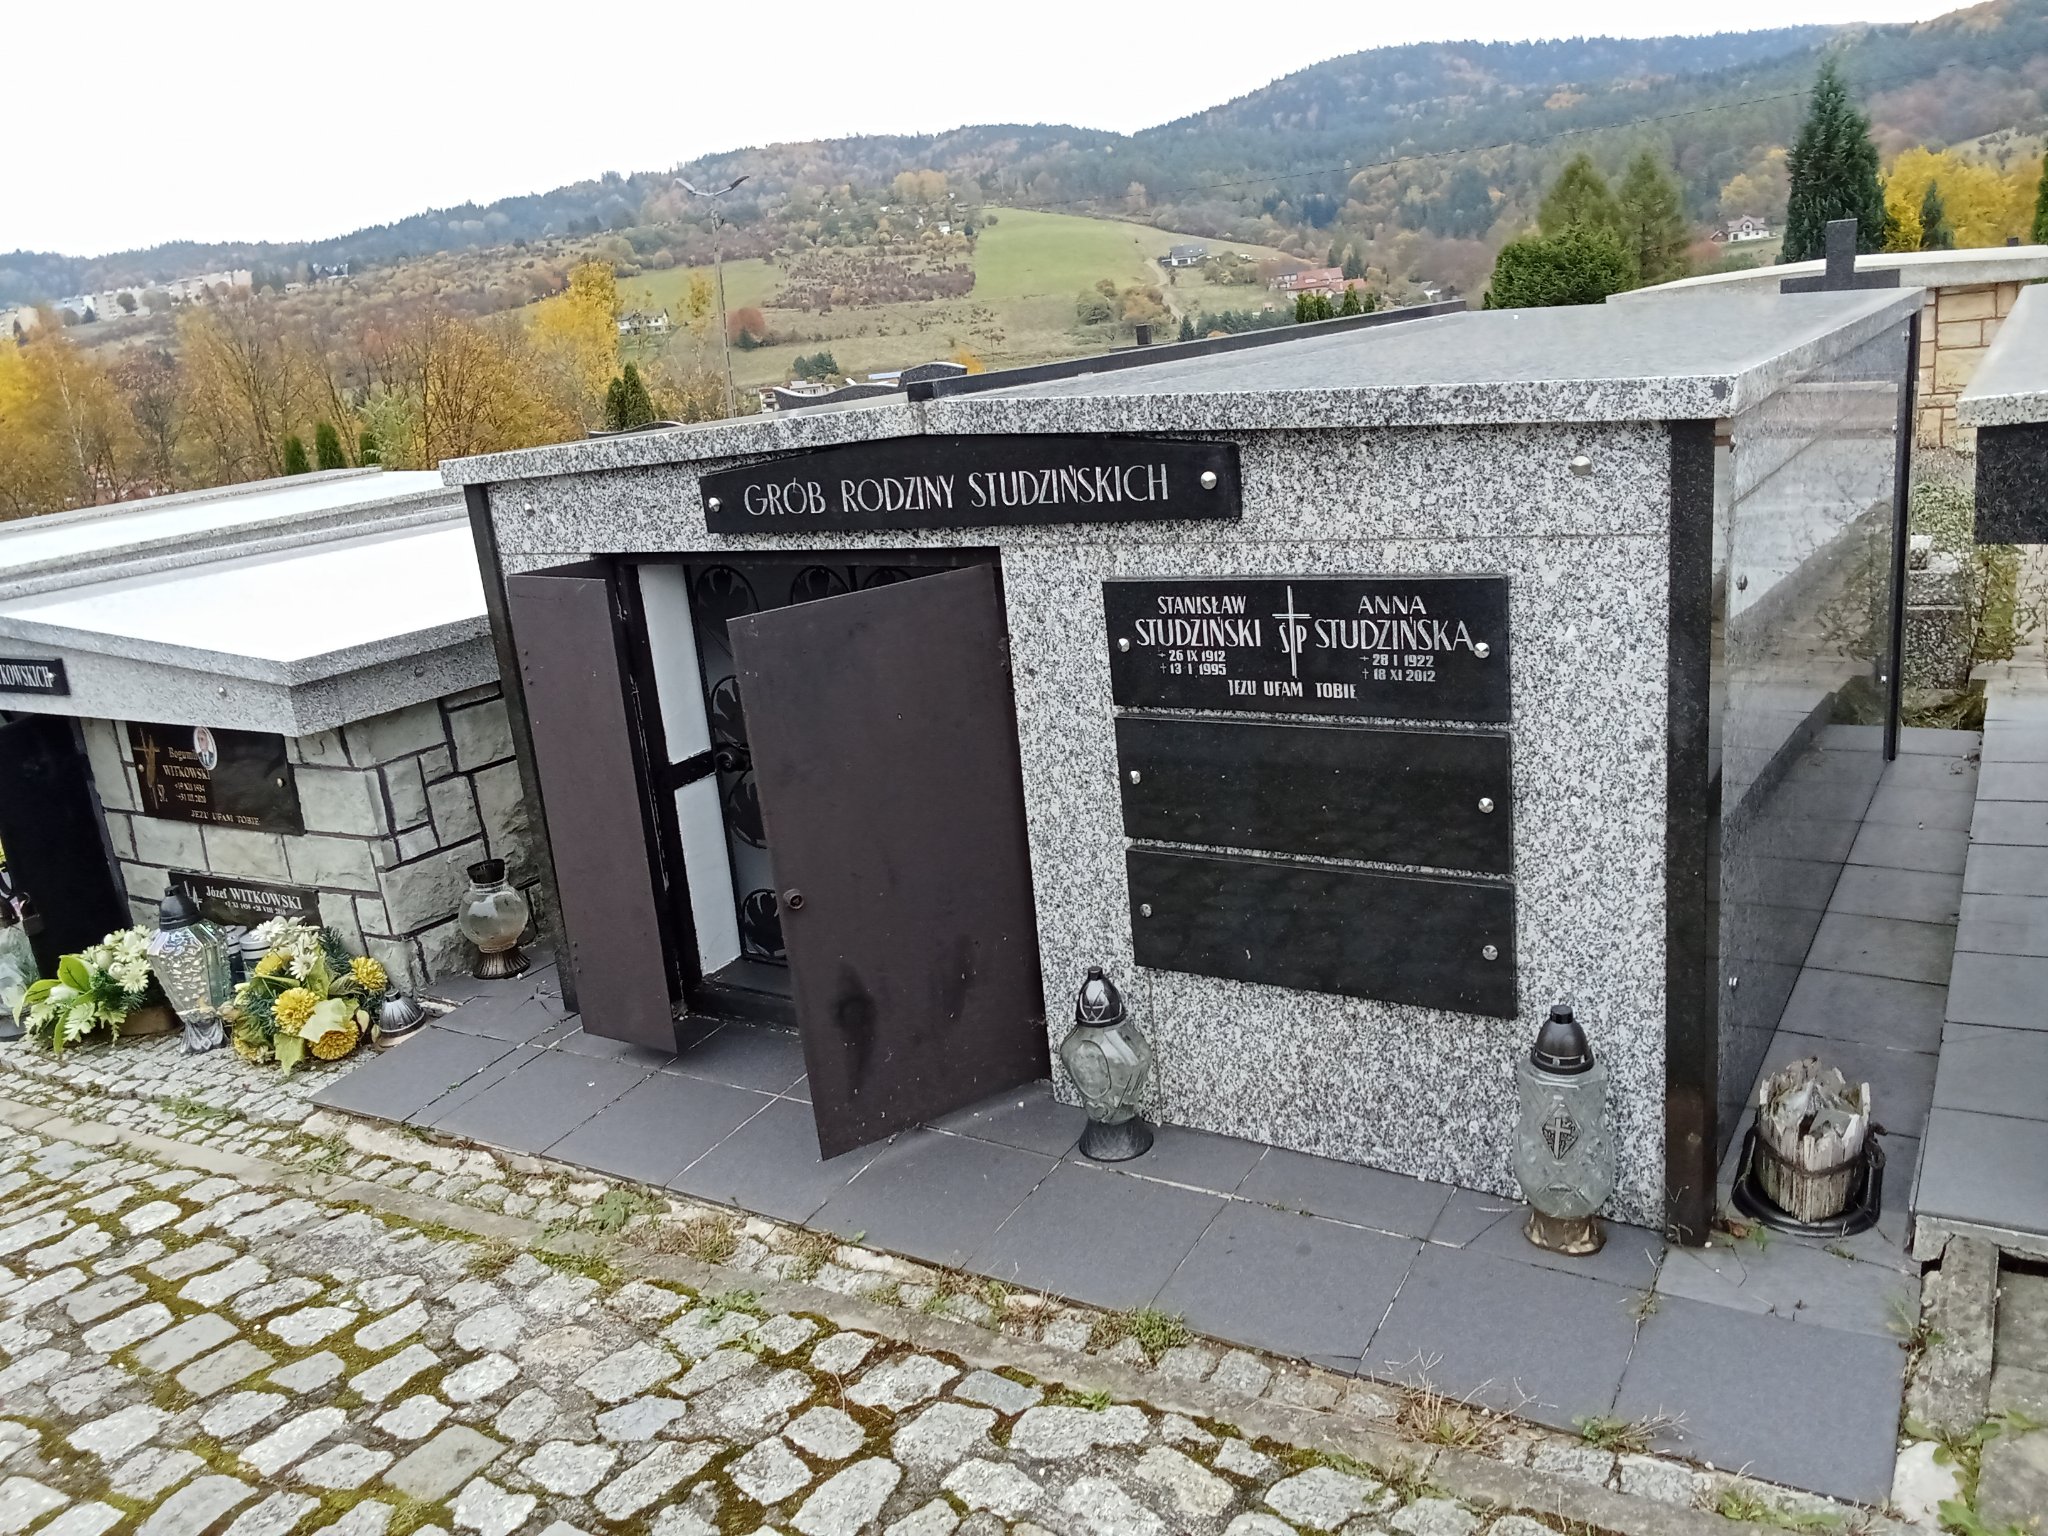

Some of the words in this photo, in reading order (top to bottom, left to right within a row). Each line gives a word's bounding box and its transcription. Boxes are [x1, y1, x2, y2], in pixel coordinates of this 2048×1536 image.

[744, 475, 827, 516] GRÓB
[841, 474, 956, 513] RODZINY
[968, 463, 1169, 509] STUDZIŃSKICH
[1157, 595, 1246, 615] STANISŁAW
[1357, 595, 1427, 615] ANNA
[1134, 616, 1262, 648] STUDZIŃSKI
[1314, 616, 1475, 651] STUDZIŃSKA
[1168, 649, 1184, 662] 26
[1187, 650, 1198, 662] IX
[1201, 650, 1226, 662] 1912
[1372, 653, 1389, 666] 28
[1404, 655, 1434, 668] 1922
[1169, 662, 1182, 674] 13
[1199, 663, 1227, 676] 1995
[1373, 668, 1387, 681] 18
[1390, 669, 1402, 681] XI
[1406, 670, 1436, 682] 2012
[1228, 680, 1257, 696] JEZU
[1263, 681, 1303, 697] UFAM
[1315, 682, 1358, 699] TOBIE
[205, 885, 227, 899] Józef
[229, 887, 303, 910] WITKOWSKI
